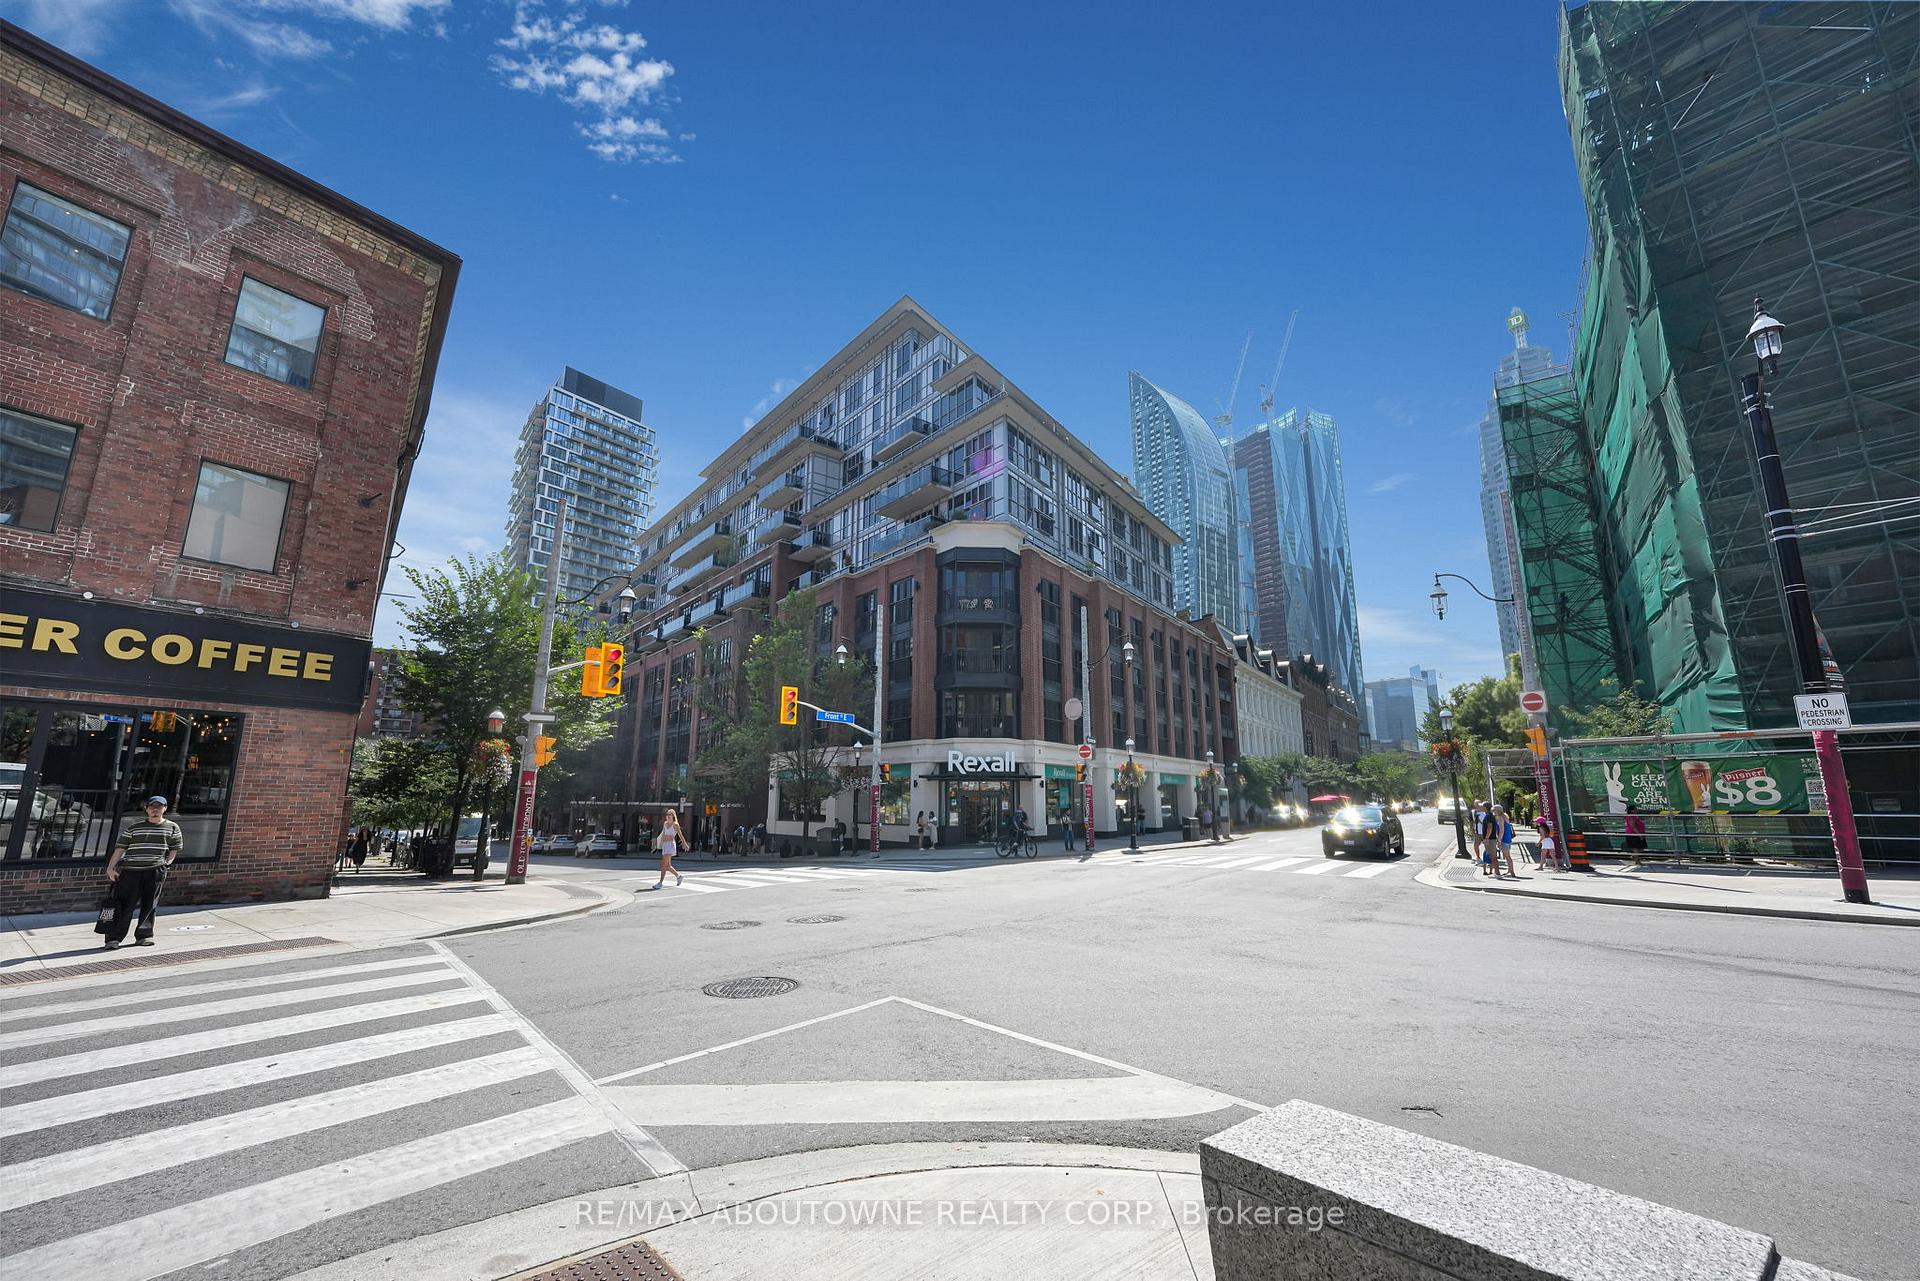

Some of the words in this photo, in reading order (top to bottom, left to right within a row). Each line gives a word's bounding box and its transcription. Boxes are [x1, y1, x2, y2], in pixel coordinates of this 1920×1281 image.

[0, 613, 80, 654] ER
[103, 627, 335, 681] COFFEE
[1811, 698, 1829, 708] NO
[825, 712, 839, 720] Front
[1801, 709, 1845, 718] PEDESTRIAN
[1807, 718, 1843, 727] CROSSING
[948, 750, 1016, 775] Rexall
[1631, 780, 1666, 788] CALM
[1714, 776, 1782, 807] $8
[517, 856, 526, 874] OLD
[522, 797, 532, 829] TORONTO
